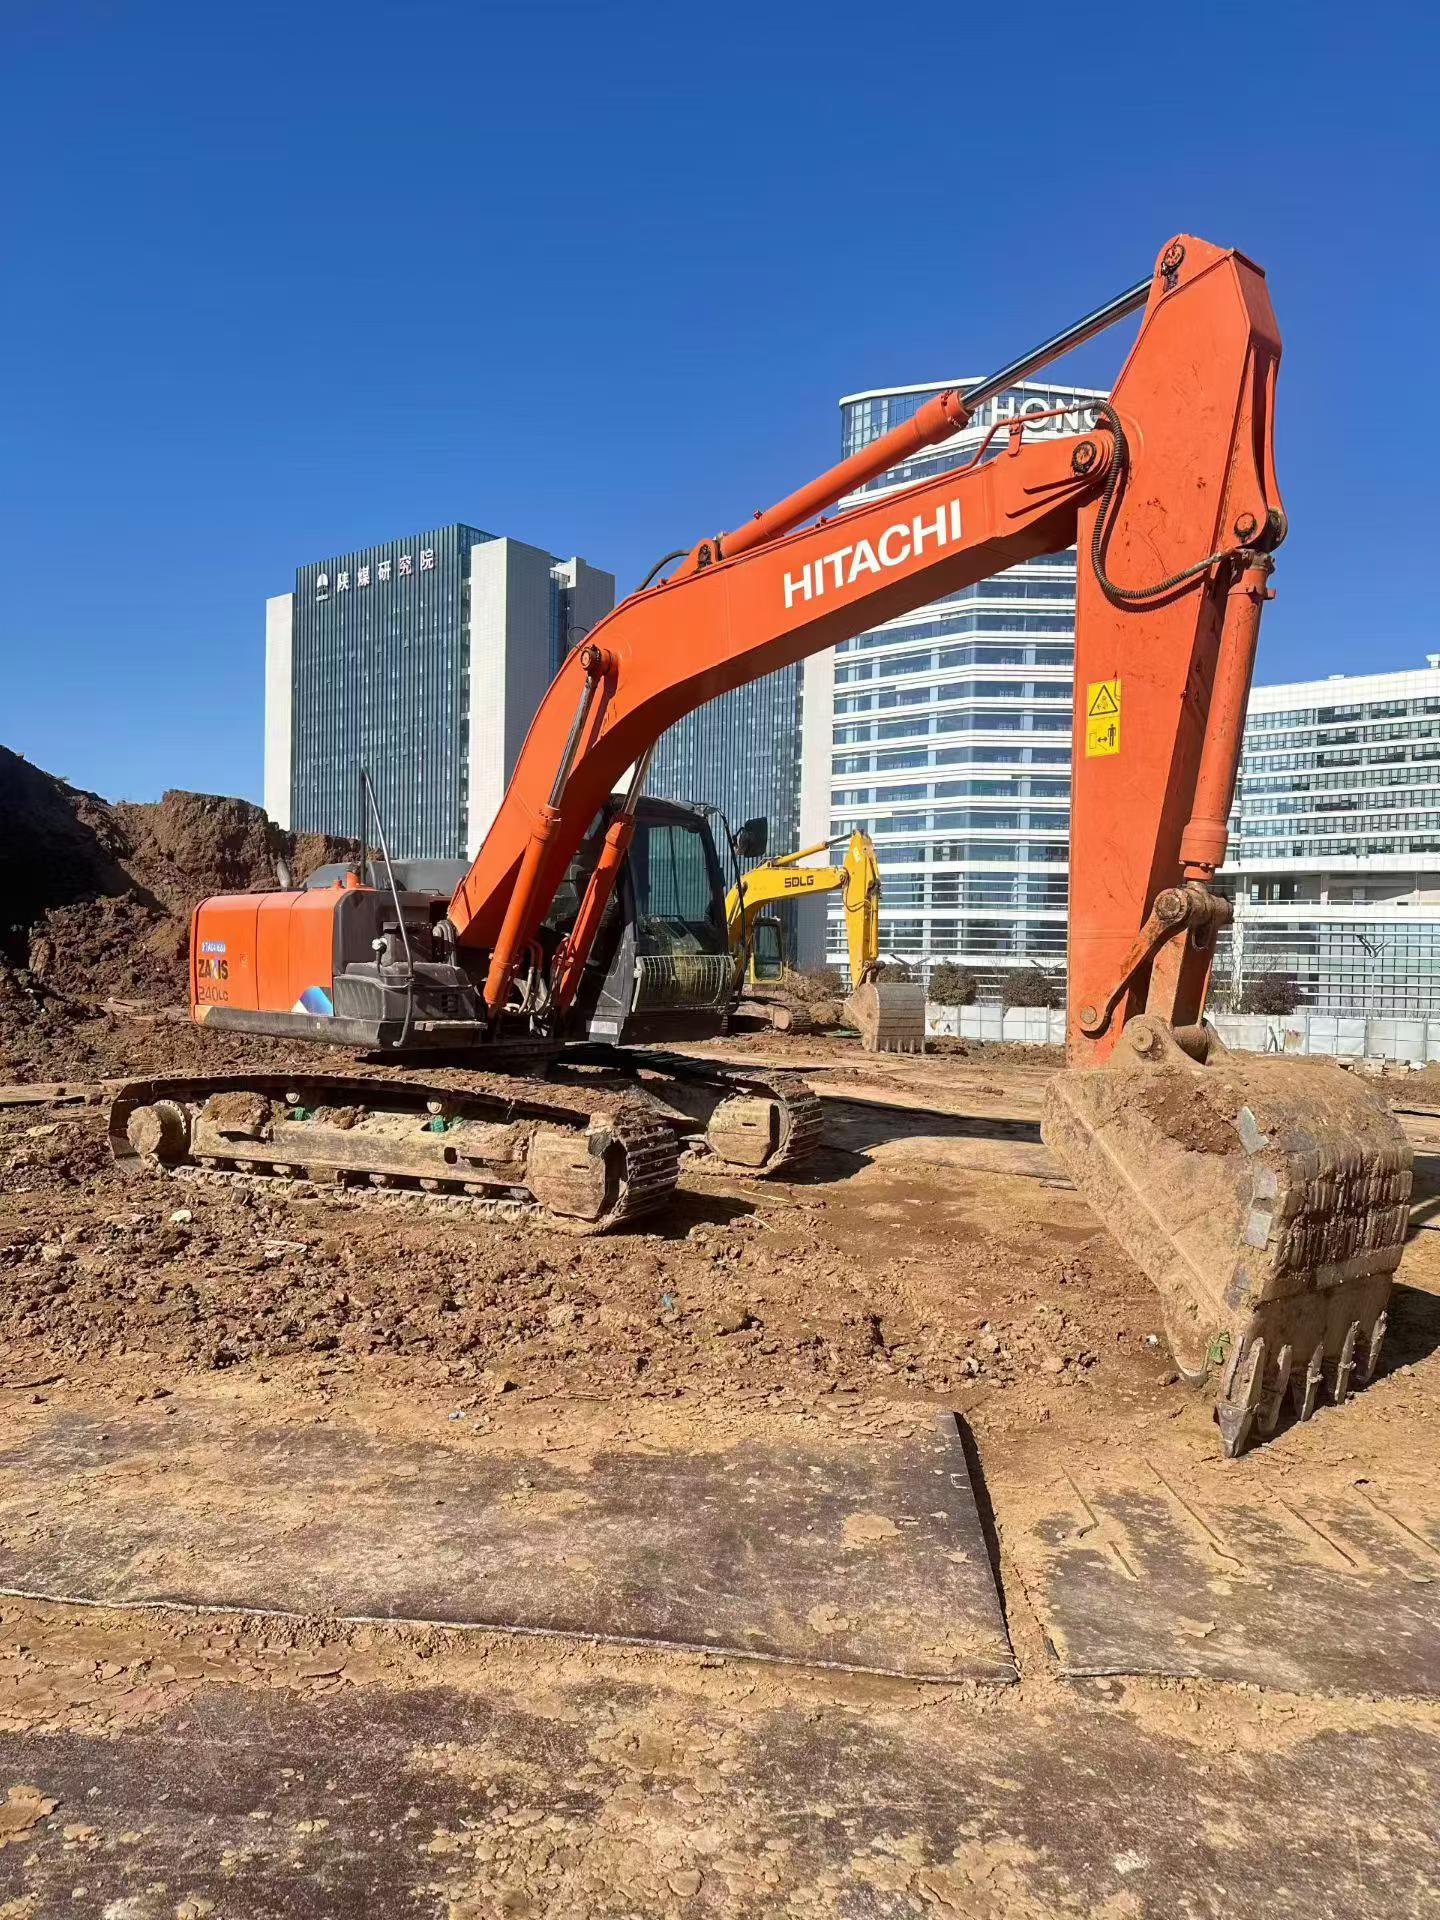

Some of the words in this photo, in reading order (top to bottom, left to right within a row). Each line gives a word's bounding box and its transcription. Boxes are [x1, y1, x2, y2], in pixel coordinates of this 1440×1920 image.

[337, 548, 434, 592] 陕煤研究院
[783, 498, 962, 609] HITACHI
[784, 875, 814, 888] SDLG
